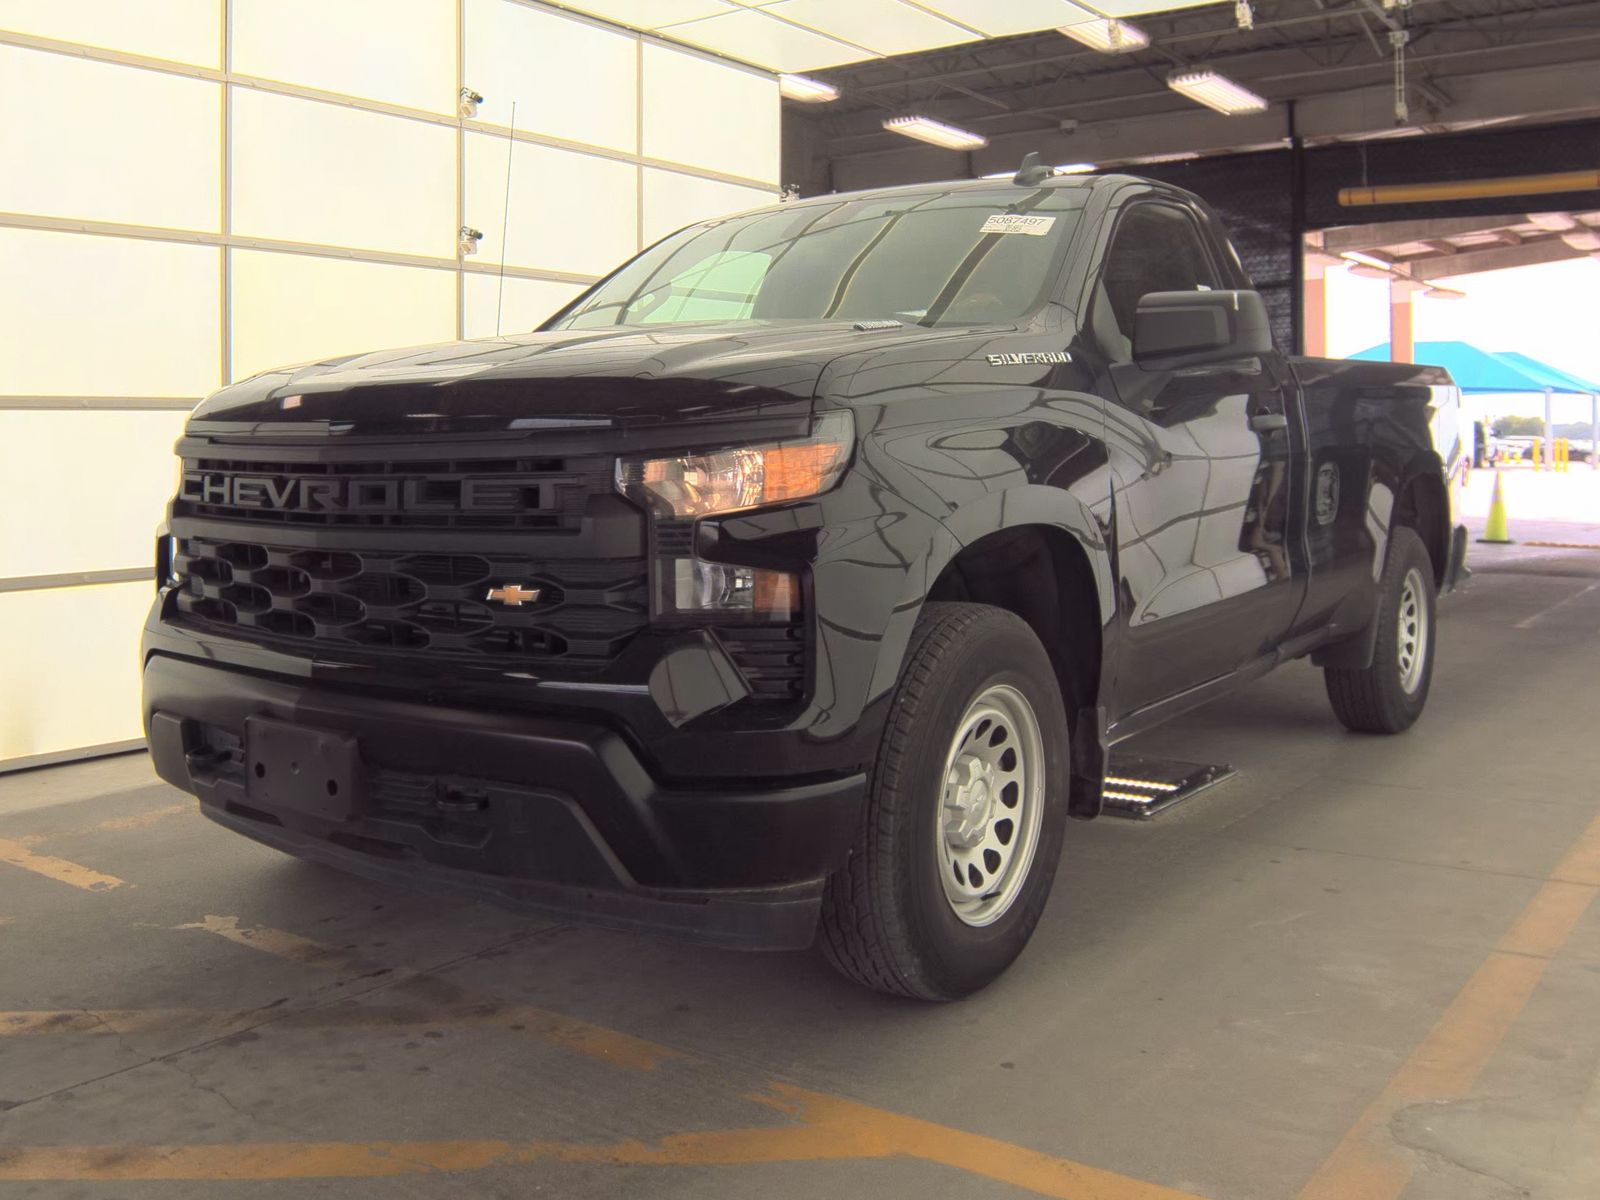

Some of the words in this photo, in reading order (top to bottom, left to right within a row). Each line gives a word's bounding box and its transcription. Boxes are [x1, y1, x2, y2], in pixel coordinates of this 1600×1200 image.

[988, 216, 1047, 226] 5087497
[986, 352, 1072, 366] SILVERADO
[179, 474, 577, 512] CHEVROLET
